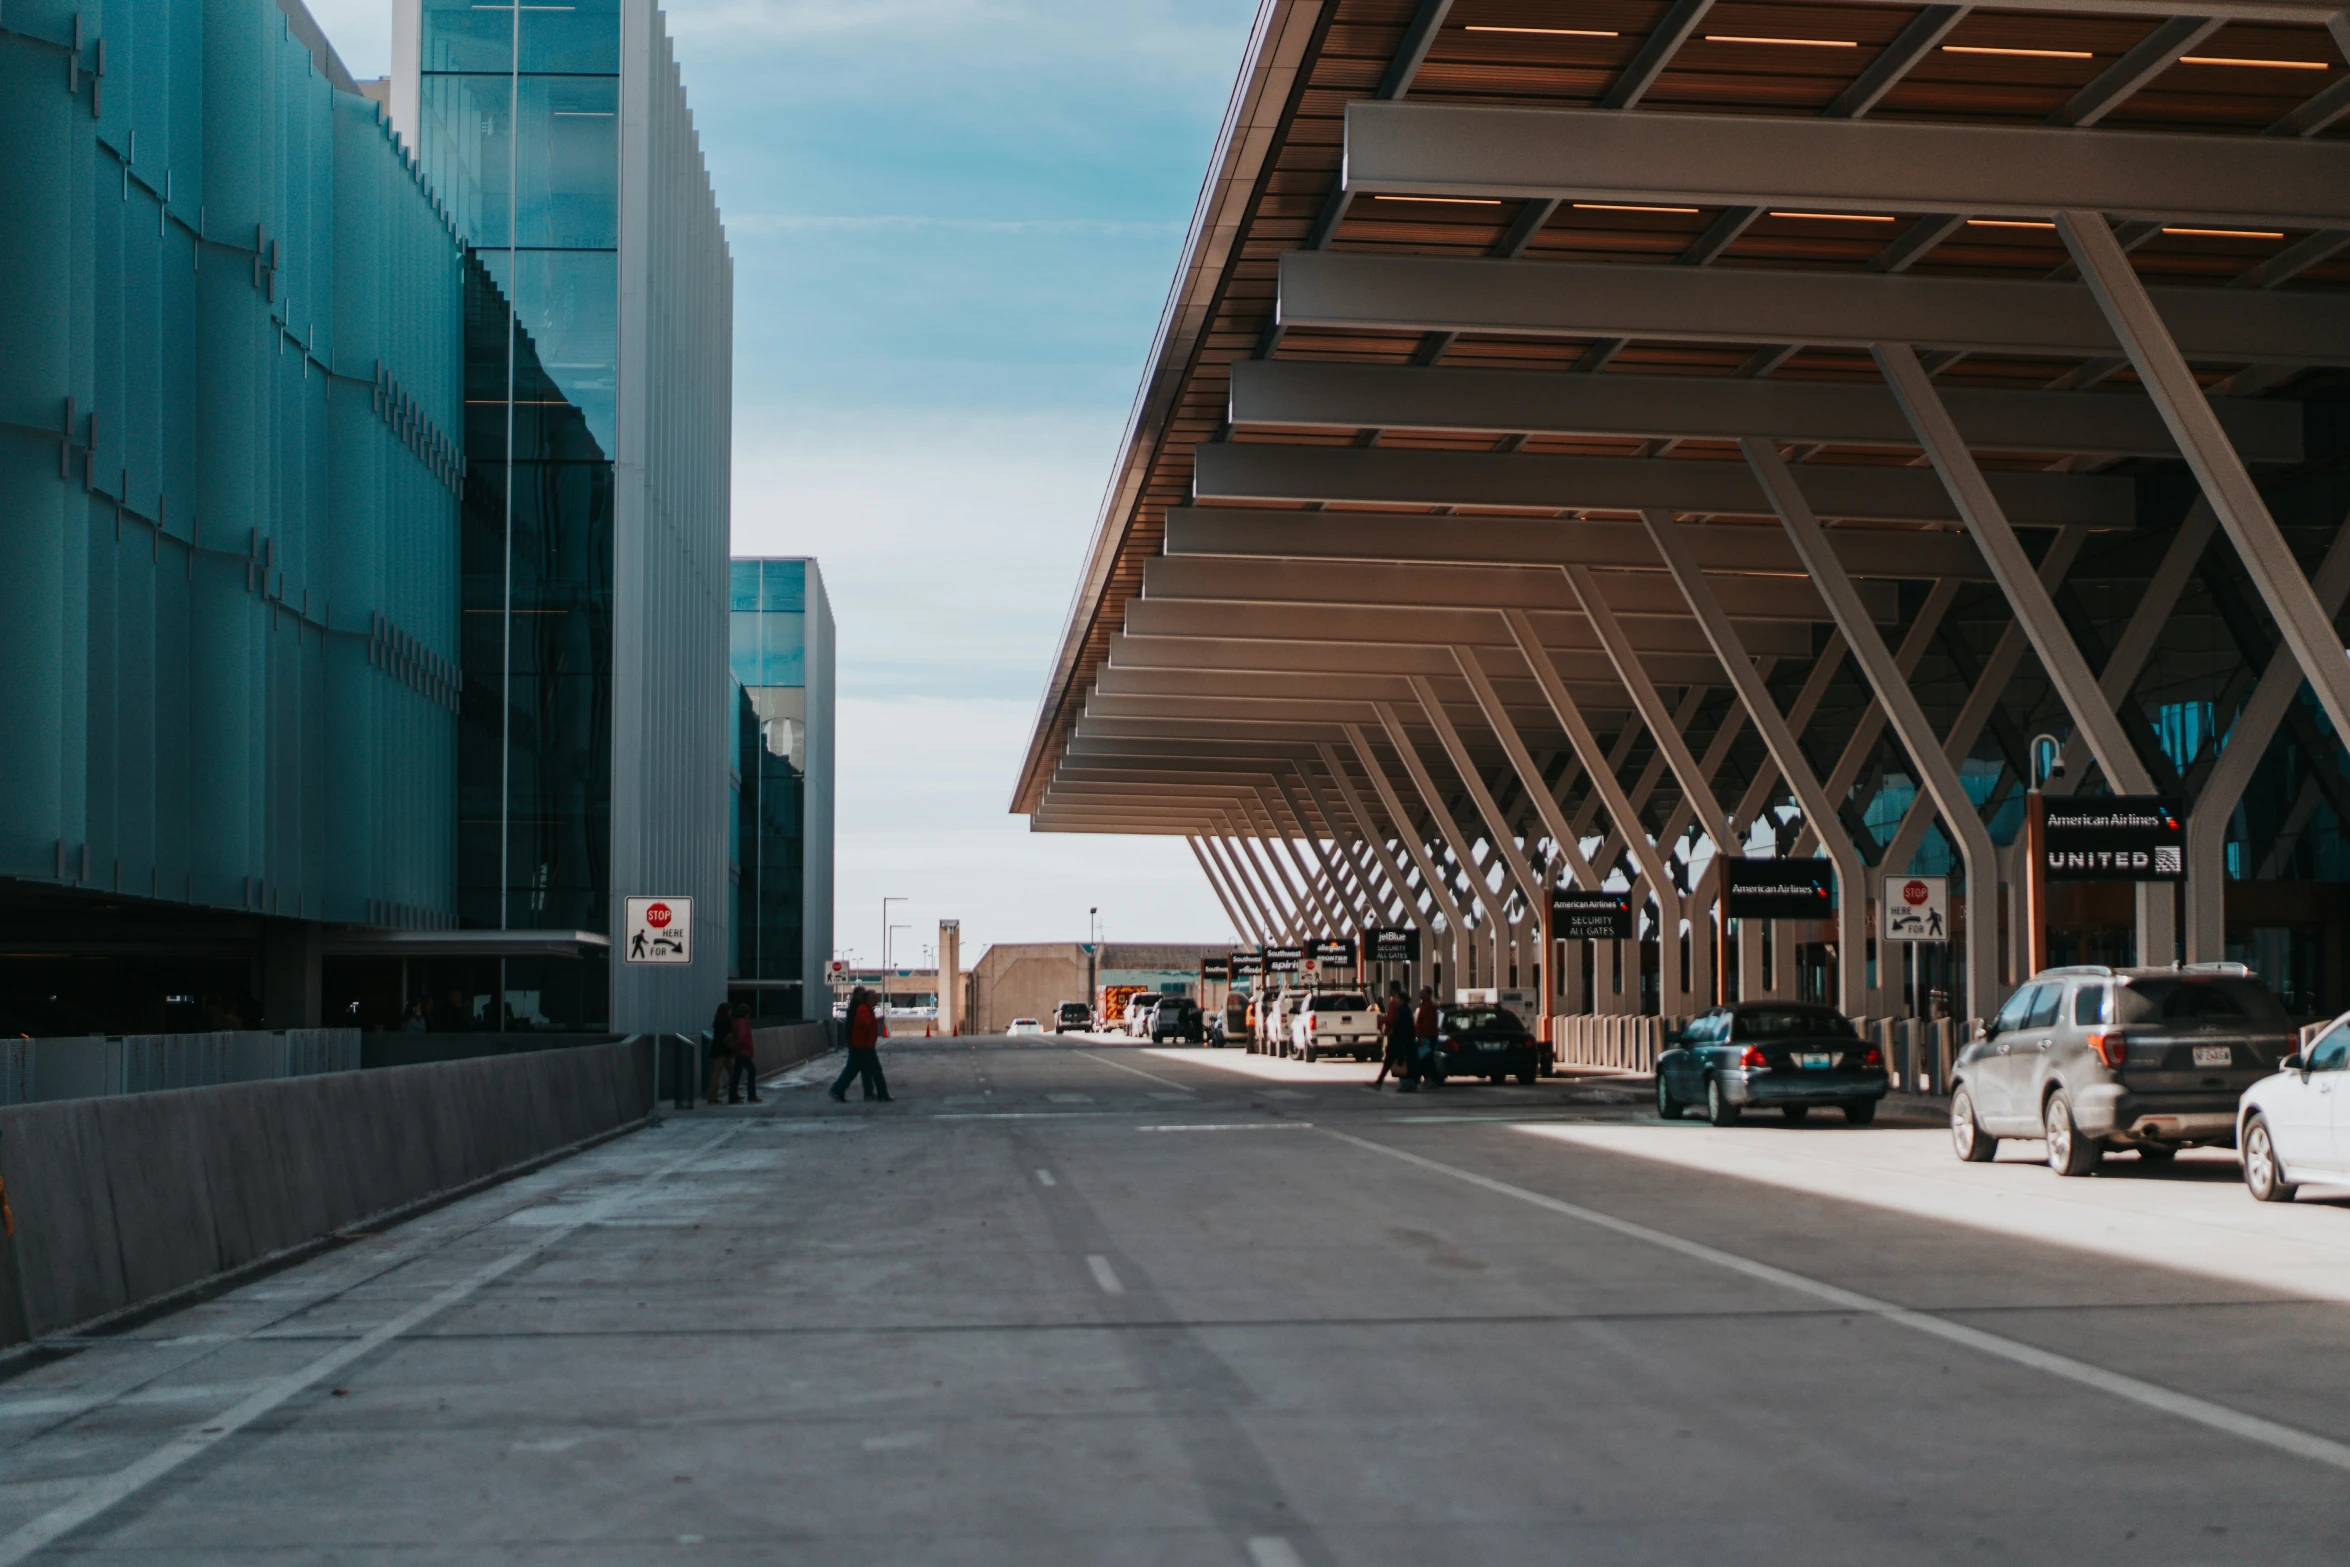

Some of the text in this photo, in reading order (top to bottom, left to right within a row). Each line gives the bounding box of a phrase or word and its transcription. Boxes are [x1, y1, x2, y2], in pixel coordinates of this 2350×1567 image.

[2048, 813, 2159, 828] American Airlines
[2048, 851, 2149, 869] UNITED
[1732, 884, 1812, 895] American Airlines
[1905, 888, 1927, 898] STOP
[1554, 900, 1616, 908] American Airlines
[648, 910, 670, 920] STOP
[1891, 906, 1912, 914] HERE
[1572, 916, 1612, 924] SECURITY
[662, 928, 684, 937] HERE
[1570, 926, 1614, 936] ALL GATES
[1908, 925, 1924, 933] FOR
[1378, 932, 1406, 942] jetBlue
[650, 947, 666, 956] FOR
